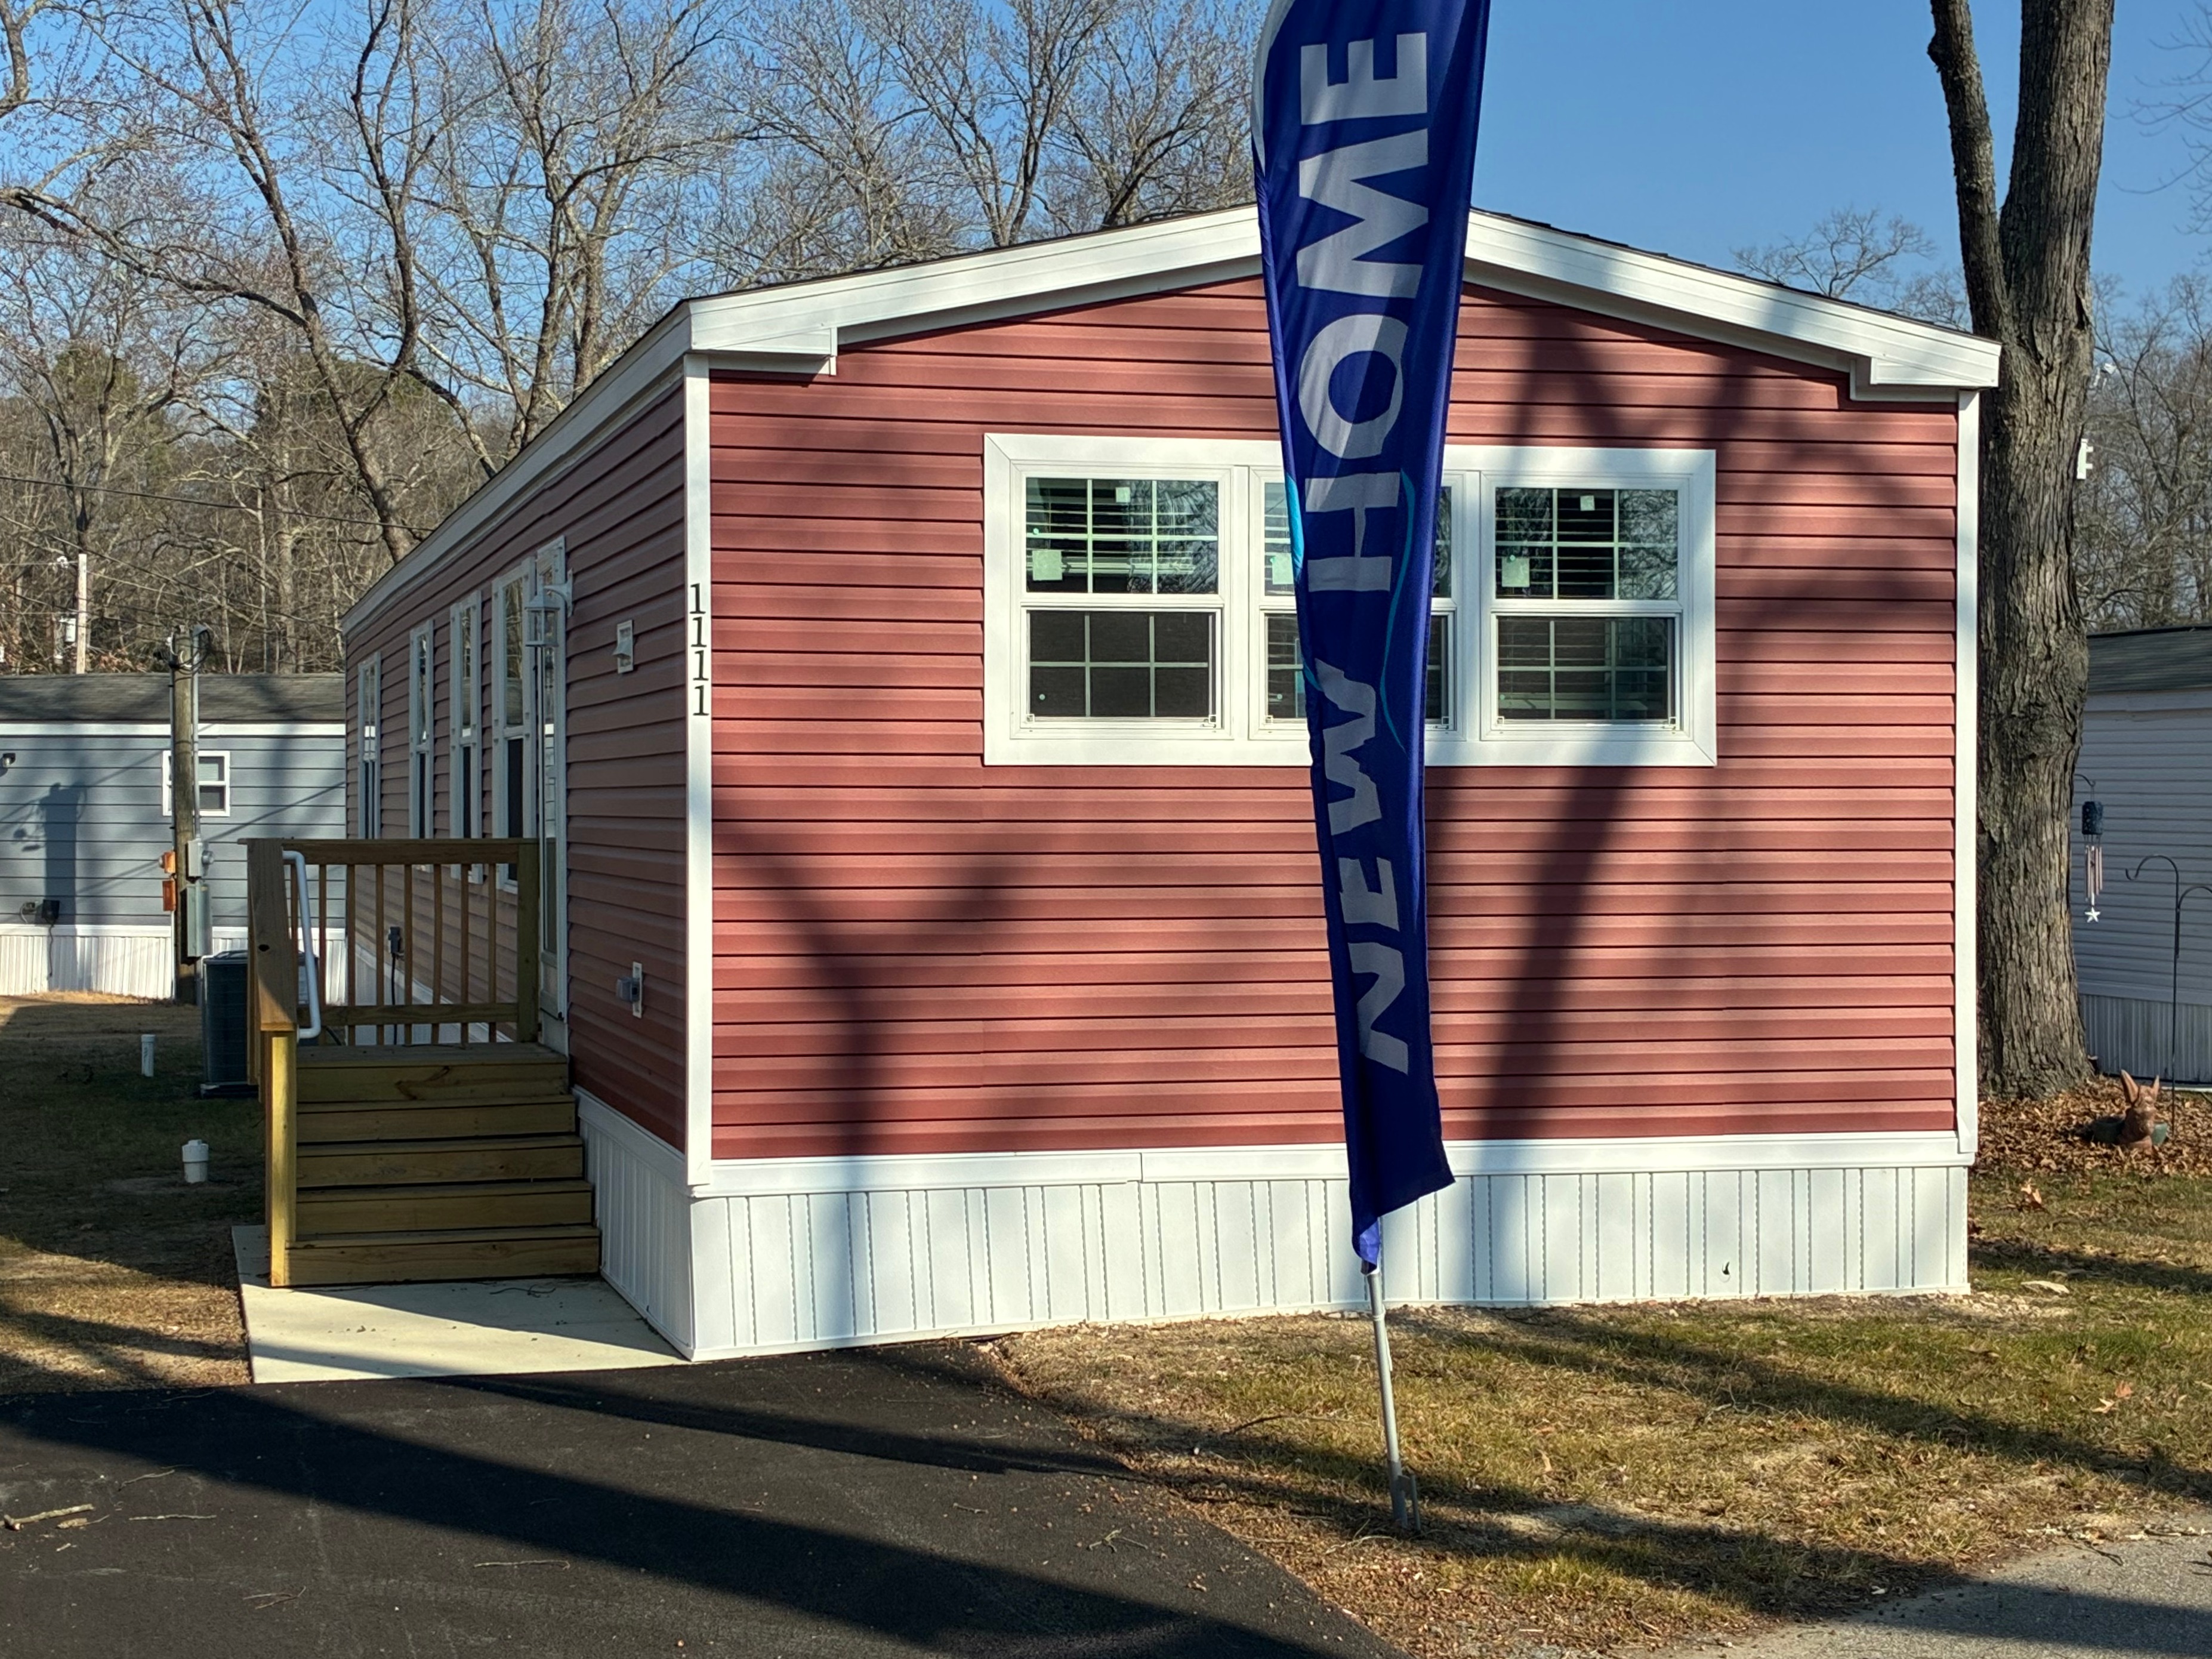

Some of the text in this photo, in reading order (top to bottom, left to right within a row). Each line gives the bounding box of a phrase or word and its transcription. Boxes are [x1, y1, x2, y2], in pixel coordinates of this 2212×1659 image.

[689, 582, 709, 716] 1111
[1297, 32, 1429, 1075] NEW HOME
